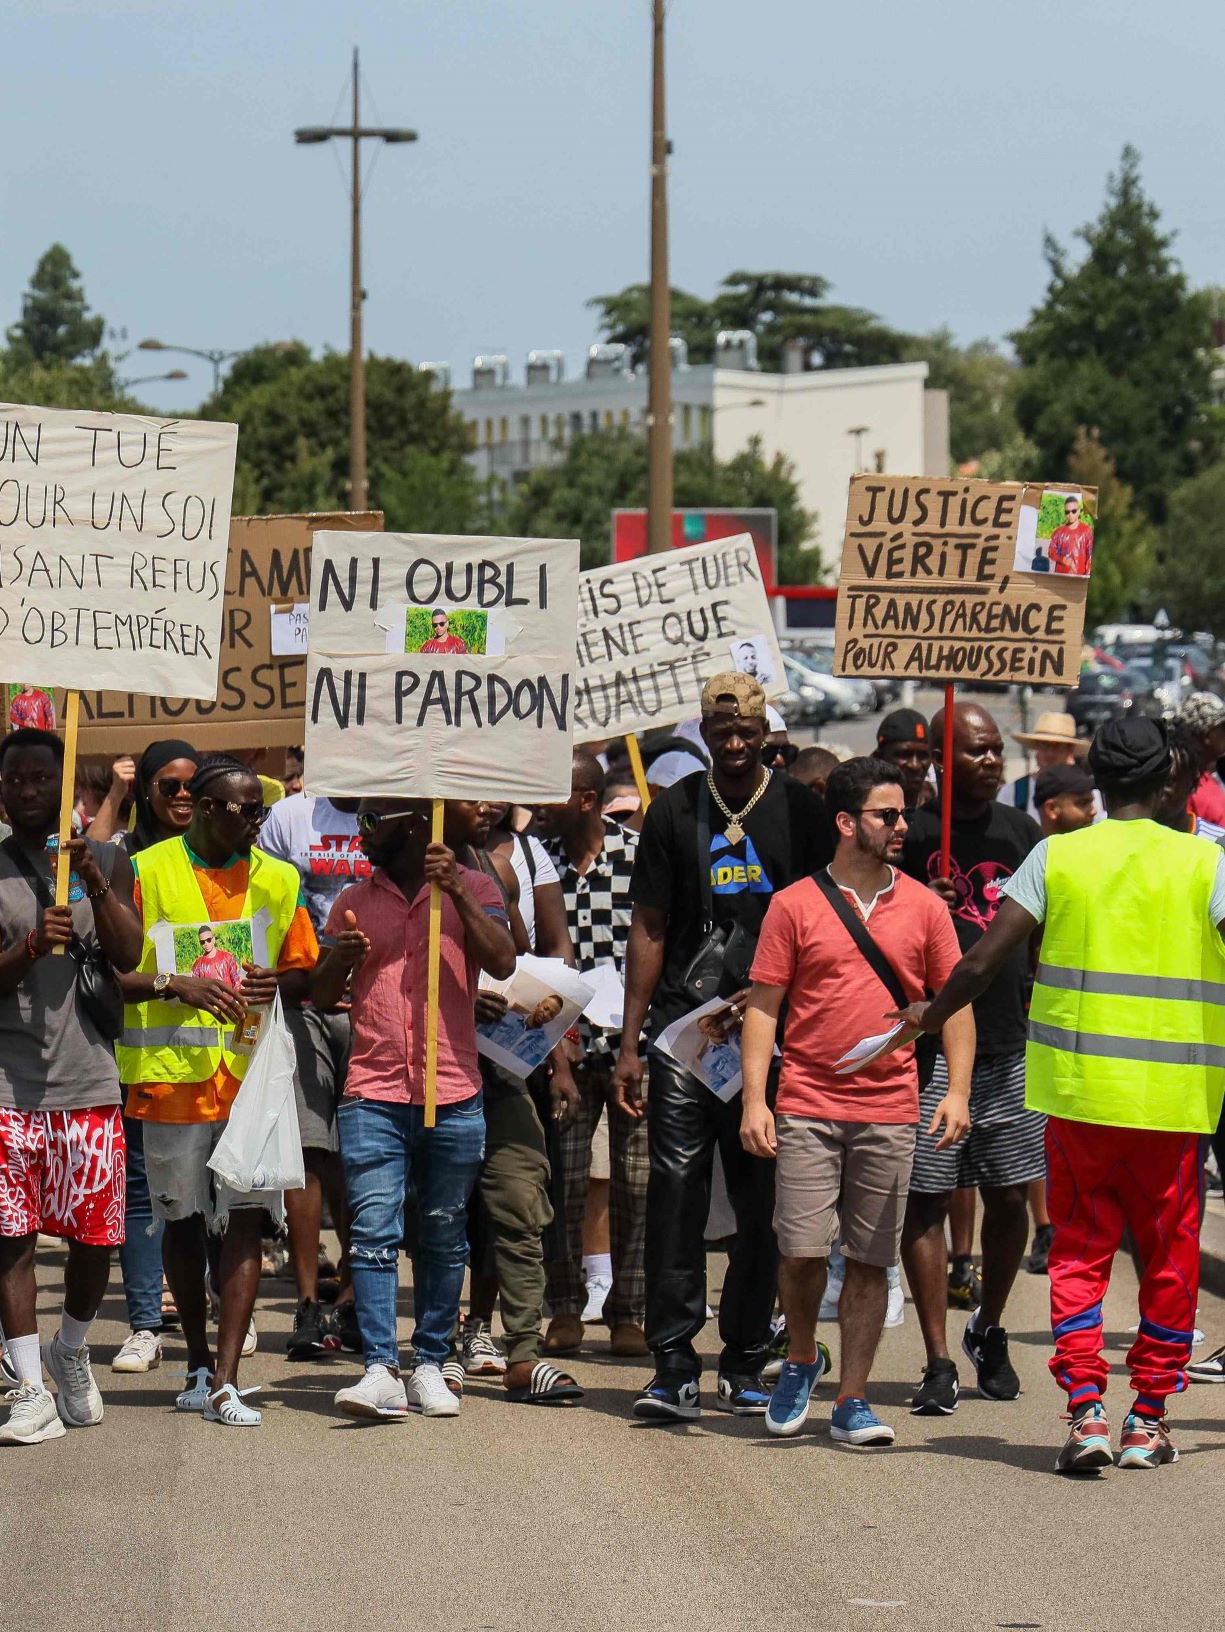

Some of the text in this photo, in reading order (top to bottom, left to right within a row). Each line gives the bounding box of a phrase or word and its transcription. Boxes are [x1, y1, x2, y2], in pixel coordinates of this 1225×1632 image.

[75, 421, 179, 471] TUÉ
[91, 489, 147, 533] UN
[156, 490, 216, 541] SOI
[858, 486, 1017, 529] JUSTICE
[129, 551, 221, 601] REFUS
[318, 556, 548, 613] NI OUBLI
[632, 566, 676, 608] DE
[680, 547, 759, 596] TUER
[857, 531, 1010, 594] VÉRITÉ,
[294, 627, 309, 644] PA
[662, 599, 737, 647] QUE
[847, 594, 1068, 636] TRANSPARENCE
[841, 637, 1065, 679] POUR ALHOUSSEIN
[311, 667, 569, 732] NI PARDON
